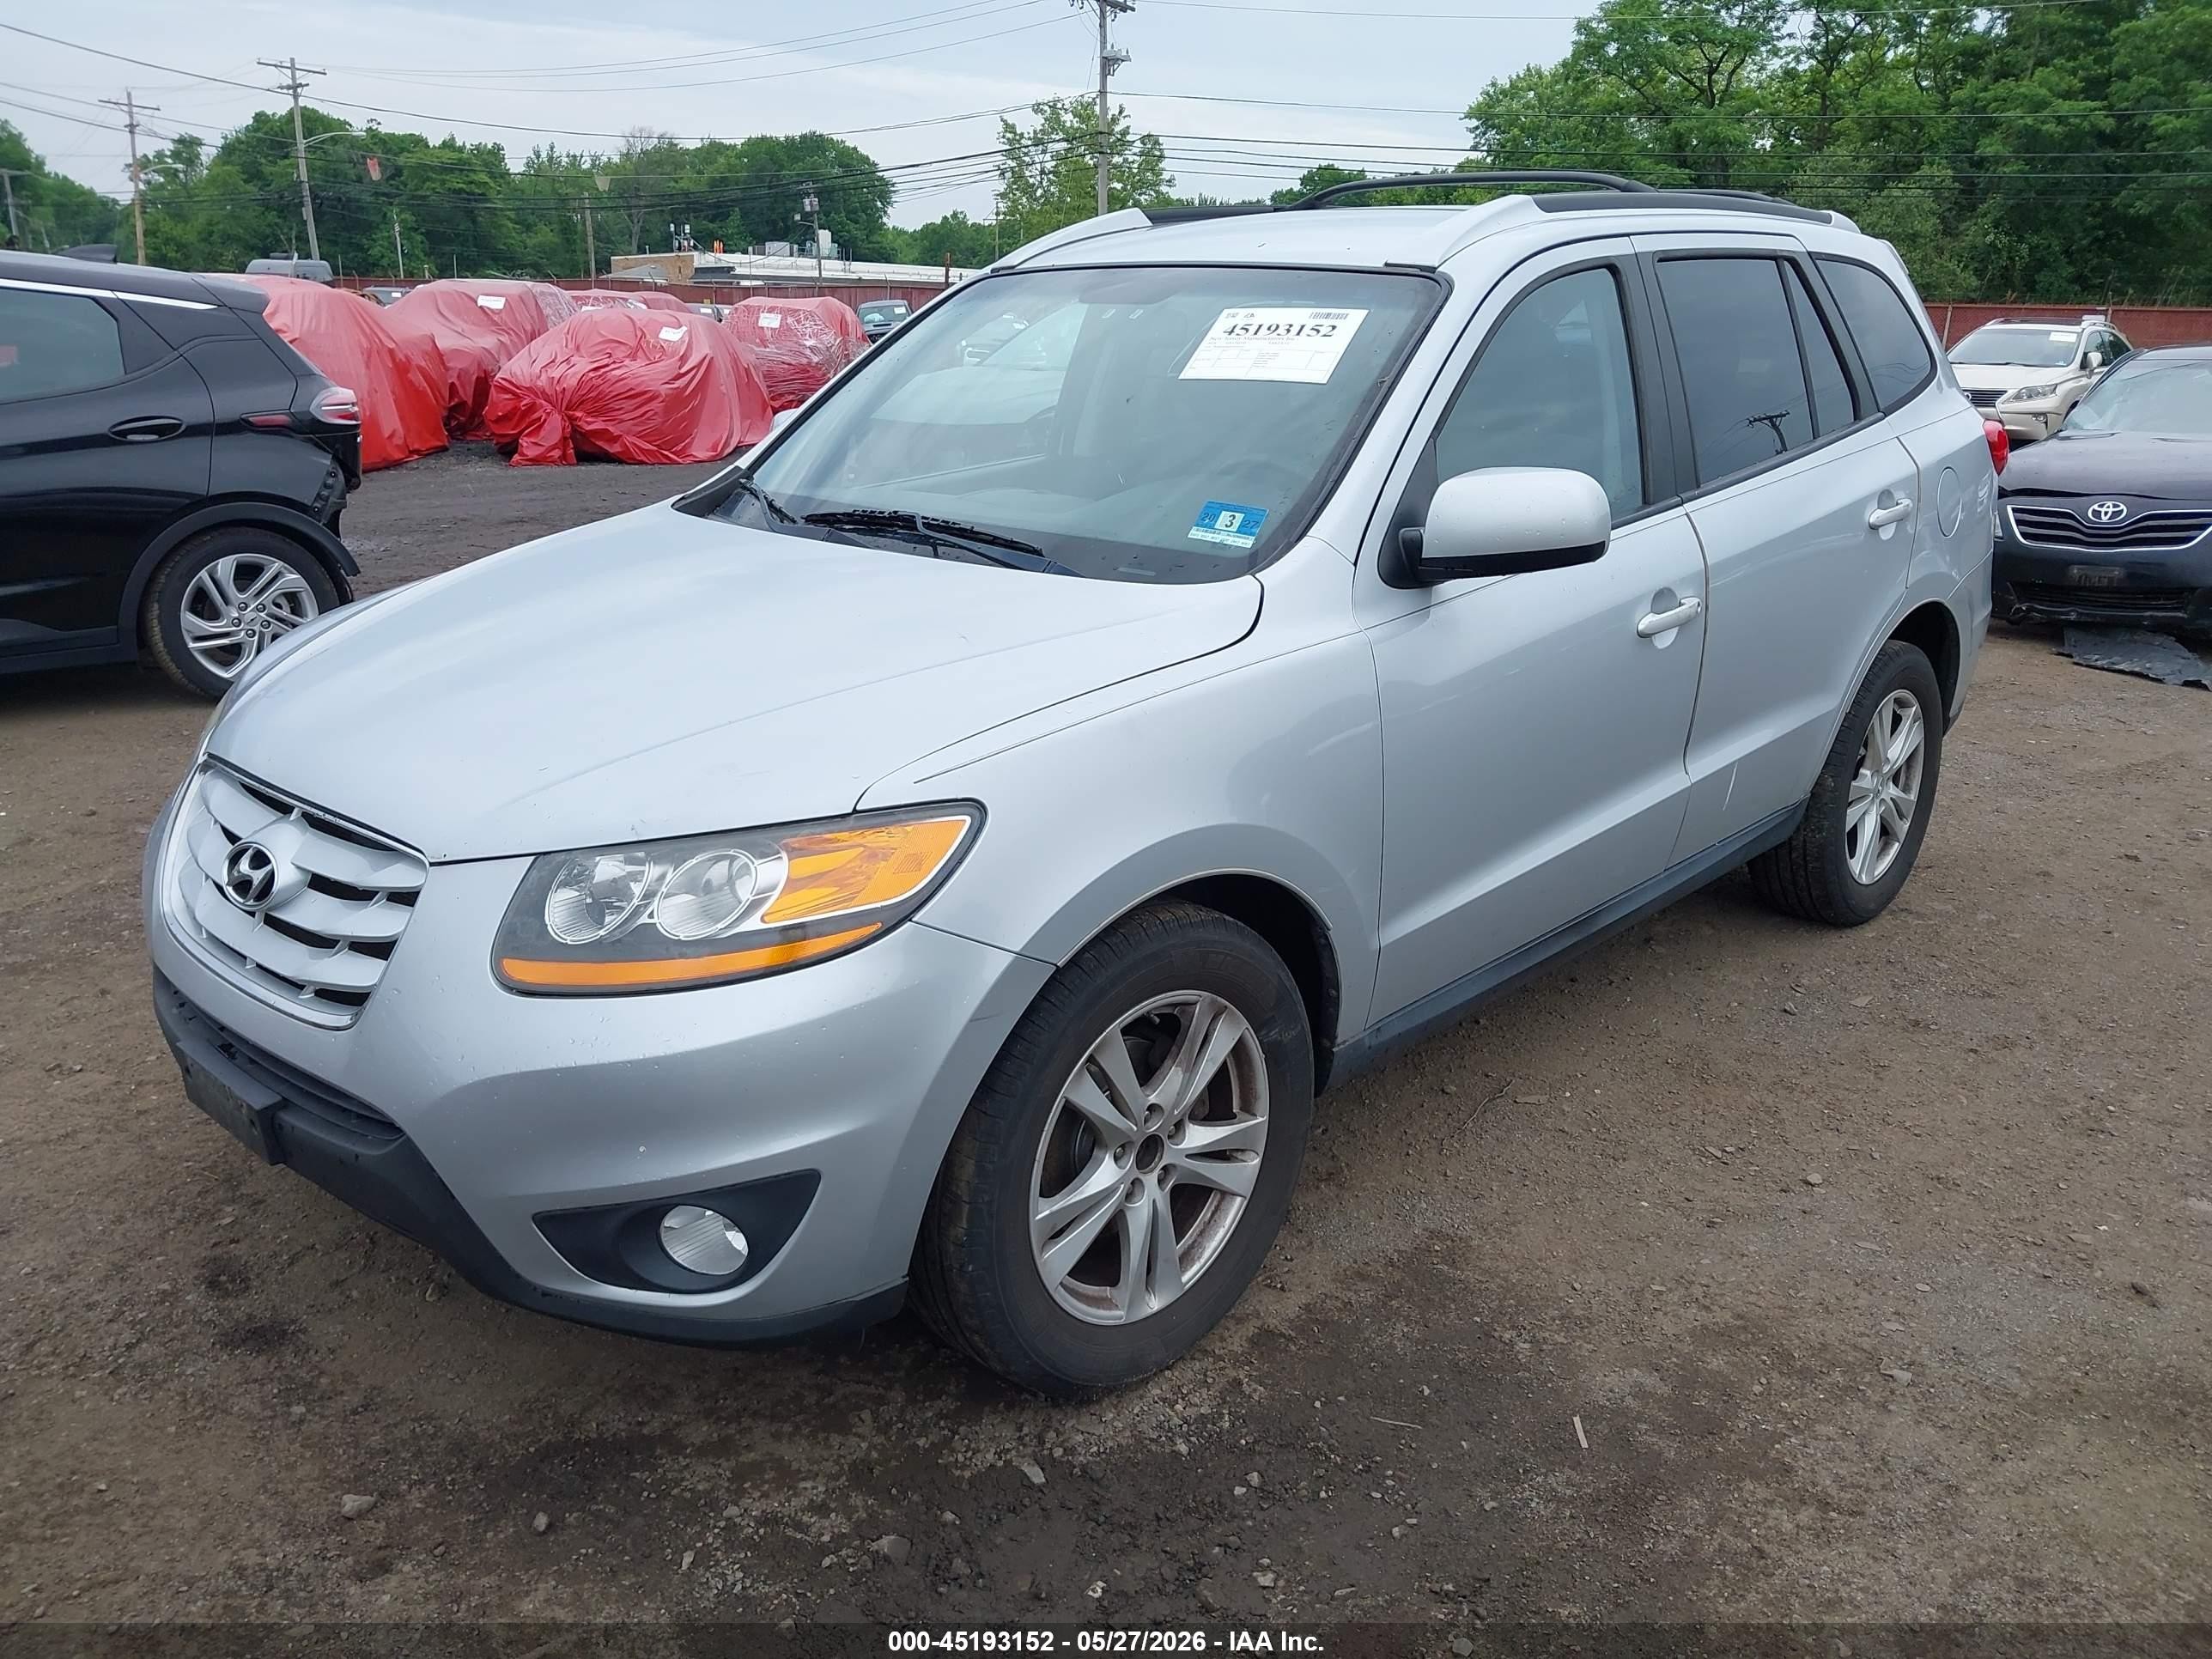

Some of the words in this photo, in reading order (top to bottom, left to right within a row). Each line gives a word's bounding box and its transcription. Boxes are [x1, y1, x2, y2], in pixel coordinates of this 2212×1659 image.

[1224, 323, 1338, 337] 45193152
[1224, 514, 1237, 528] 3
[1242, 520, 1260, 530] 27
